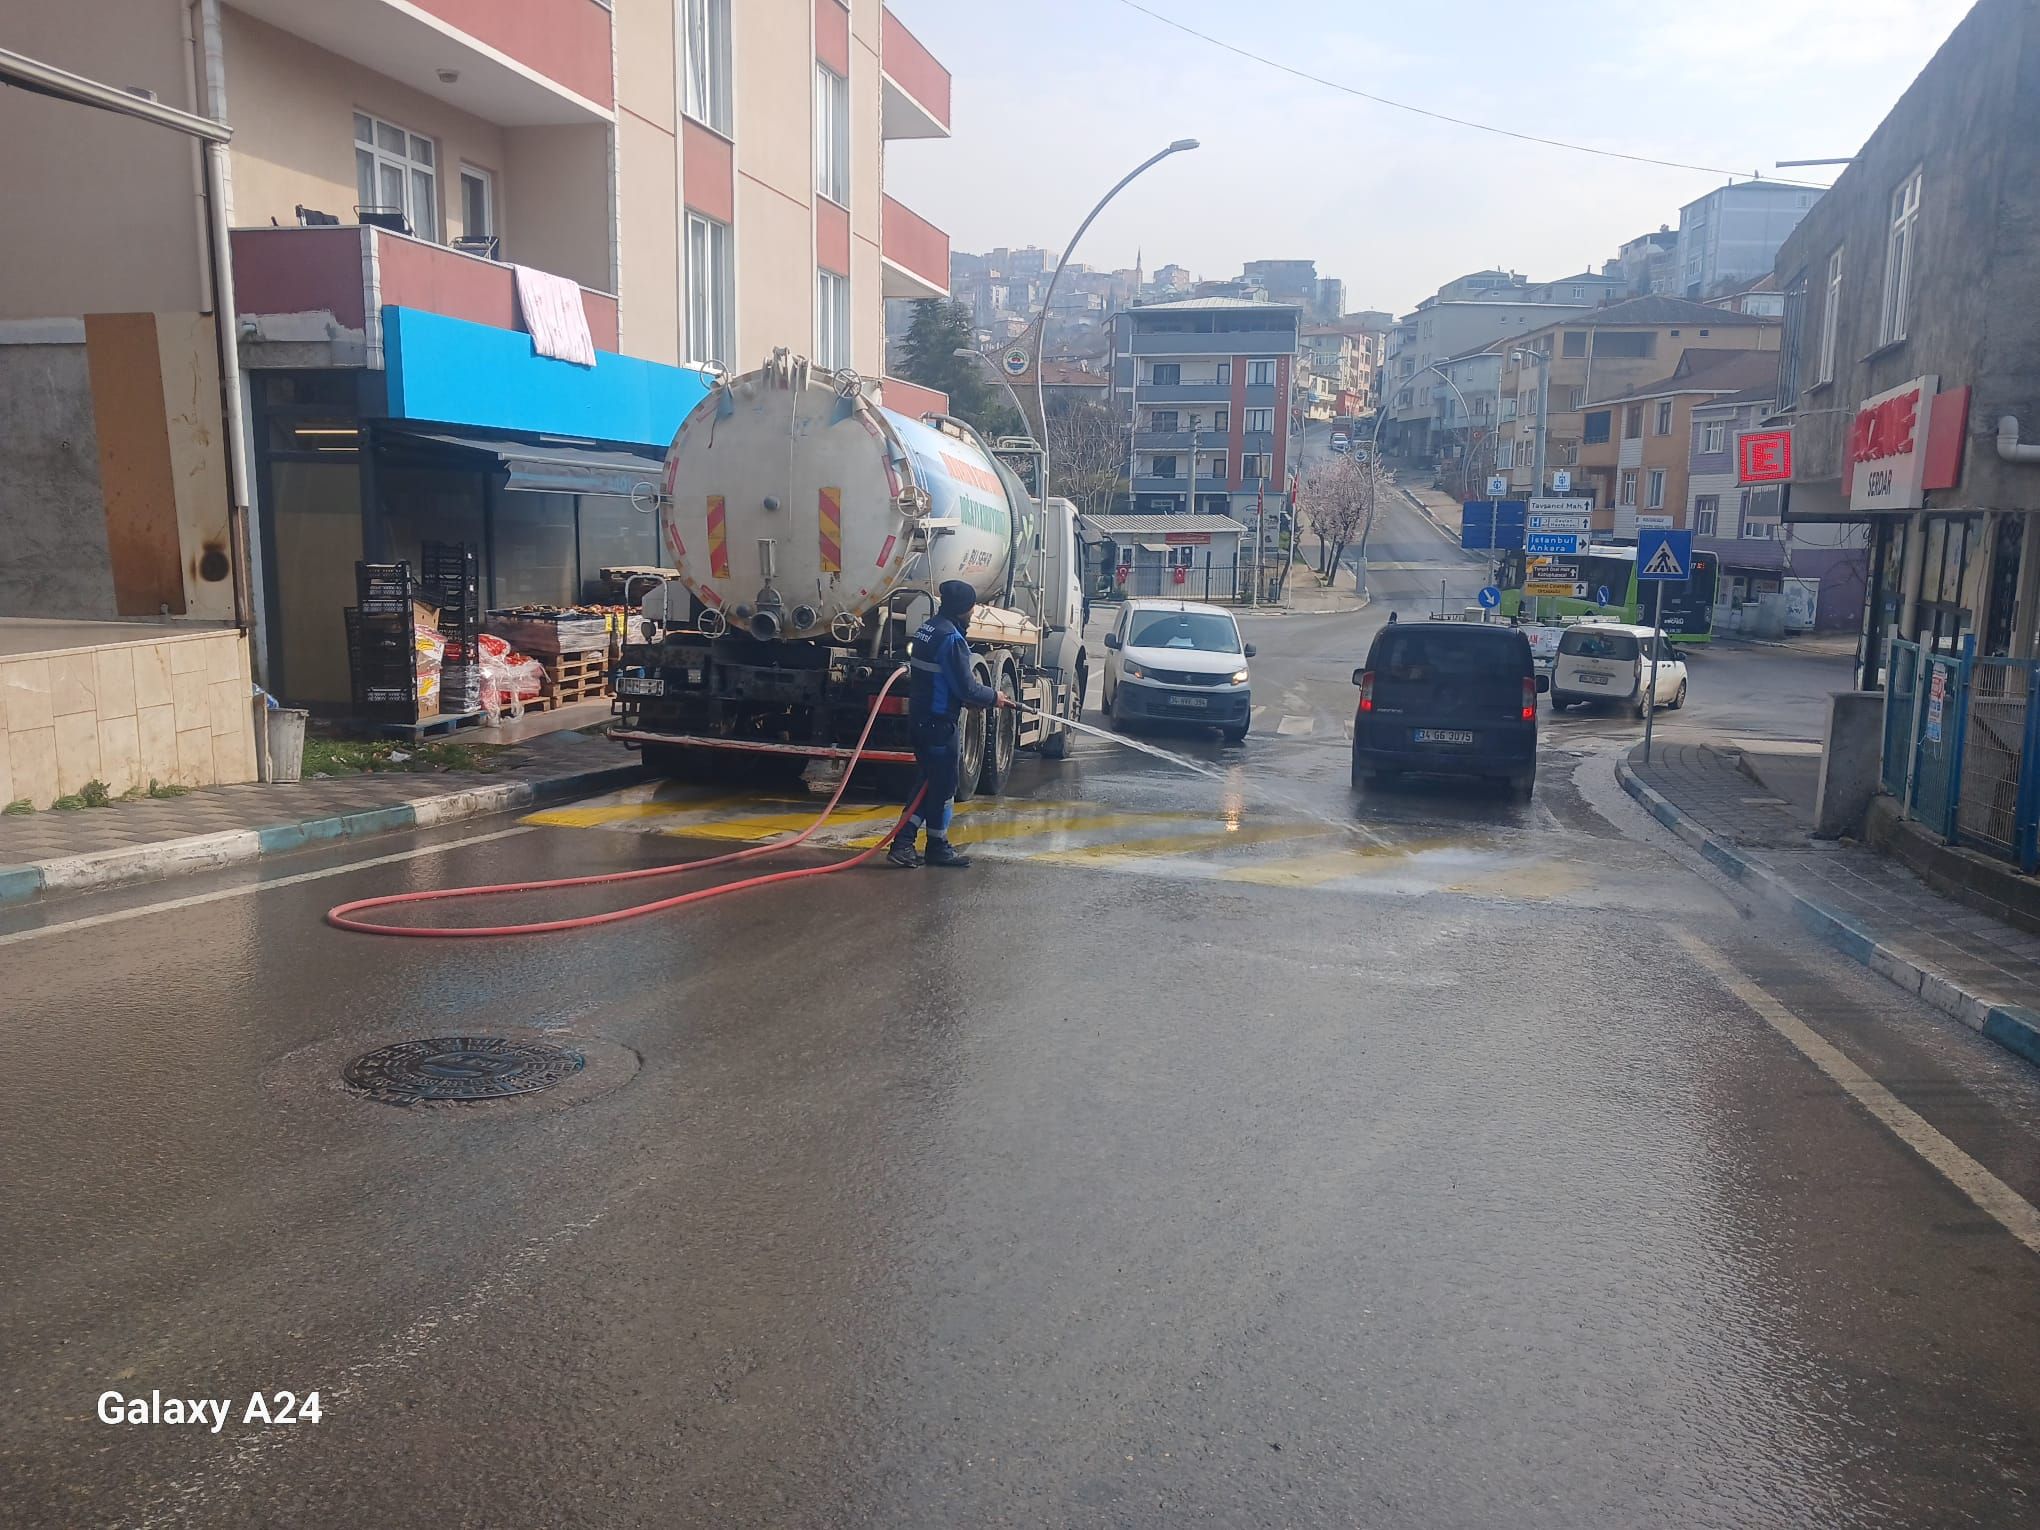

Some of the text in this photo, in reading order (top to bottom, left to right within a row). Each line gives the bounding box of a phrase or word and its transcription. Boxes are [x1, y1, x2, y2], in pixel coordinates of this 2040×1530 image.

[1867, 469, 1893, 497] SERDAR
[1531, 517, 1540, 527] H
[1531, 535, 1574, 544] İstanbul
[1419, 730, 1471, 741] 34 GG 3075
